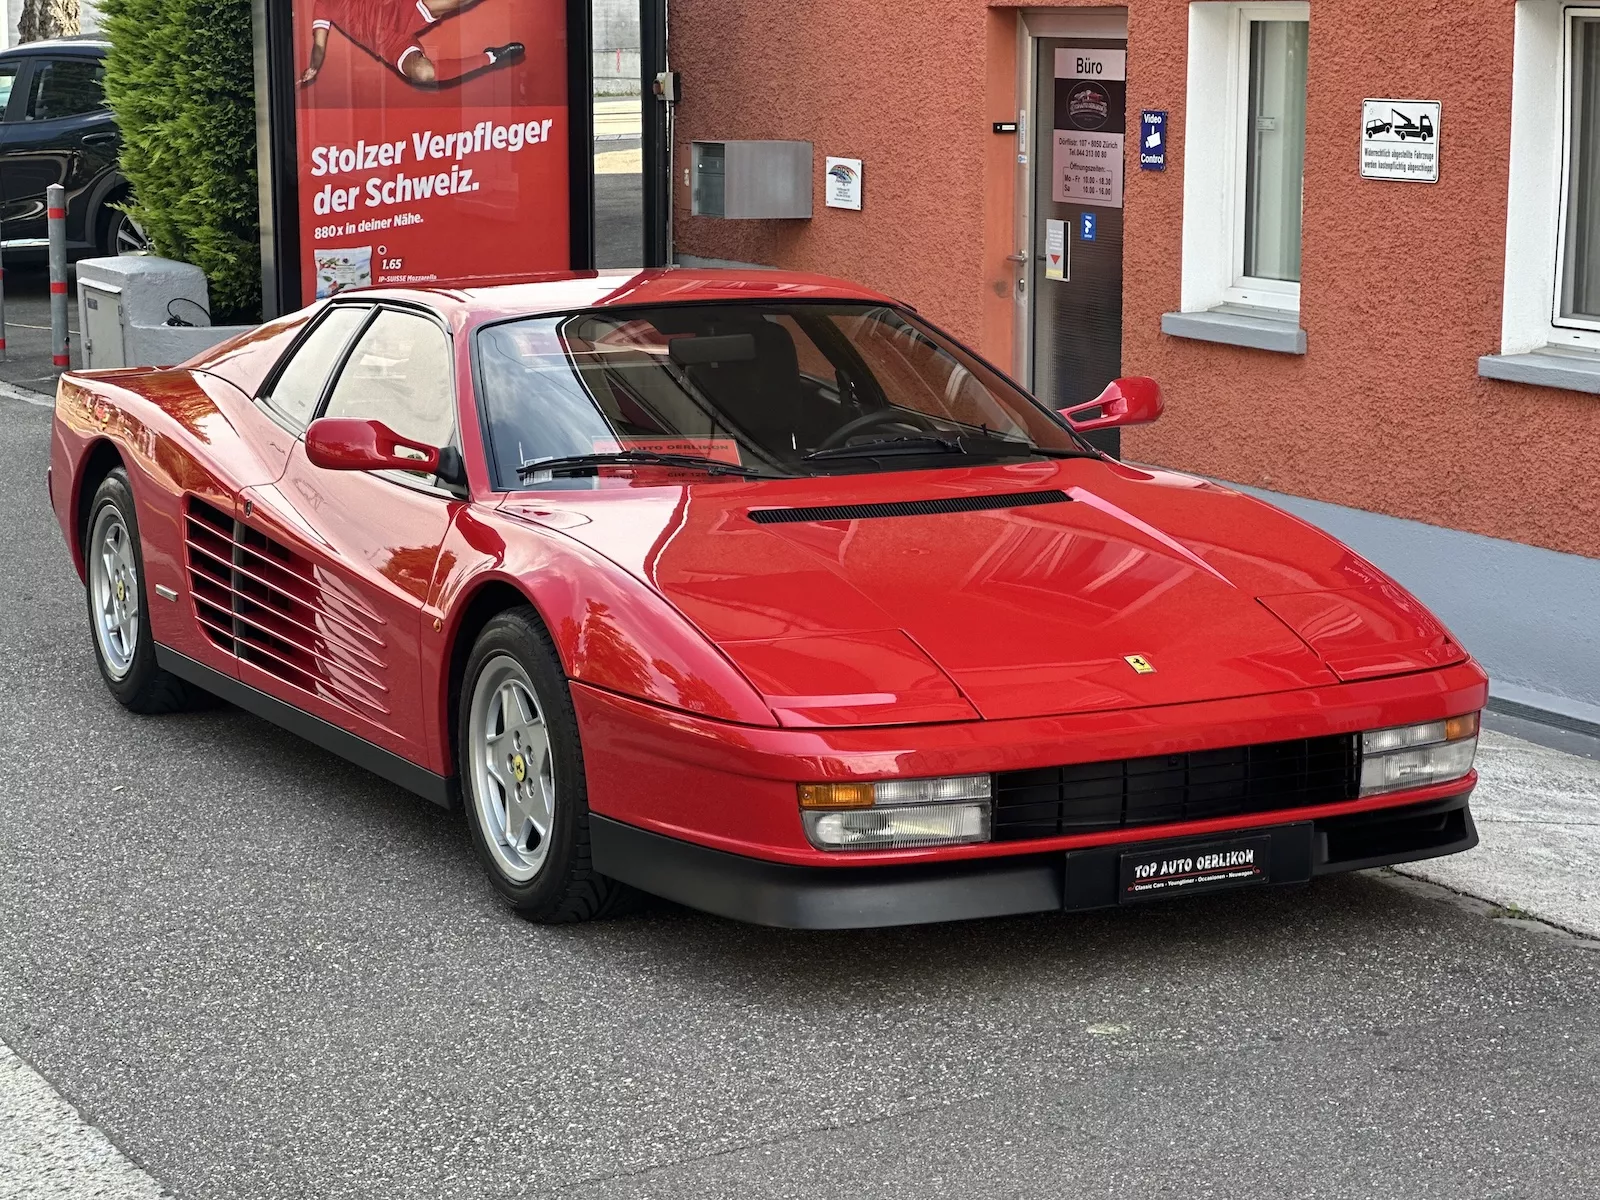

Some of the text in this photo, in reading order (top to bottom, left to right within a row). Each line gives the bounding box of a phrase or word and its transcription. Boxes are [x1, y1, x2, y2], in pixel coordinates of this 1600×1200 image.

[1076, 57, 1103, 75] Büro
[1144, 113, 1162, 124] Video
[311, 118, 553, 176] Stolzer Verpfleger
[1079, 139, 1087, 147] 107
[1091, 140, 1102, 148] 8050
[1103, 140, 1118, 149] Zürich
[1141, 153, 1164, 164] Control
[1391, 149, 1413, 160] abgestellte
[1414, 150, 1434, 162] Fahrzeuge
[1365, 160, 1377, 169] werden
[1378, 160, 1406, 173] kostenpflichtig
[1064, 174, 1071, 182] Mo
[313, 165, 480, 216] der Schweiz.
[1064, 184, 1070, 192] Sa
[345, 222, 356, 235] in
[358, 218, 392, 233] deiner
[394, 212, 424, 227] Nähe.
[381, 259, 402, 270] 1.65
[378, 274, 437, 283] IP-SUISSE Mozzarella
[1134, 849, 1254, 878] TOP AUTO OERLIKON
[1168, 878, 1194, 887] Youngtimer
[1198, 874, 1225, 882] Occasionen
